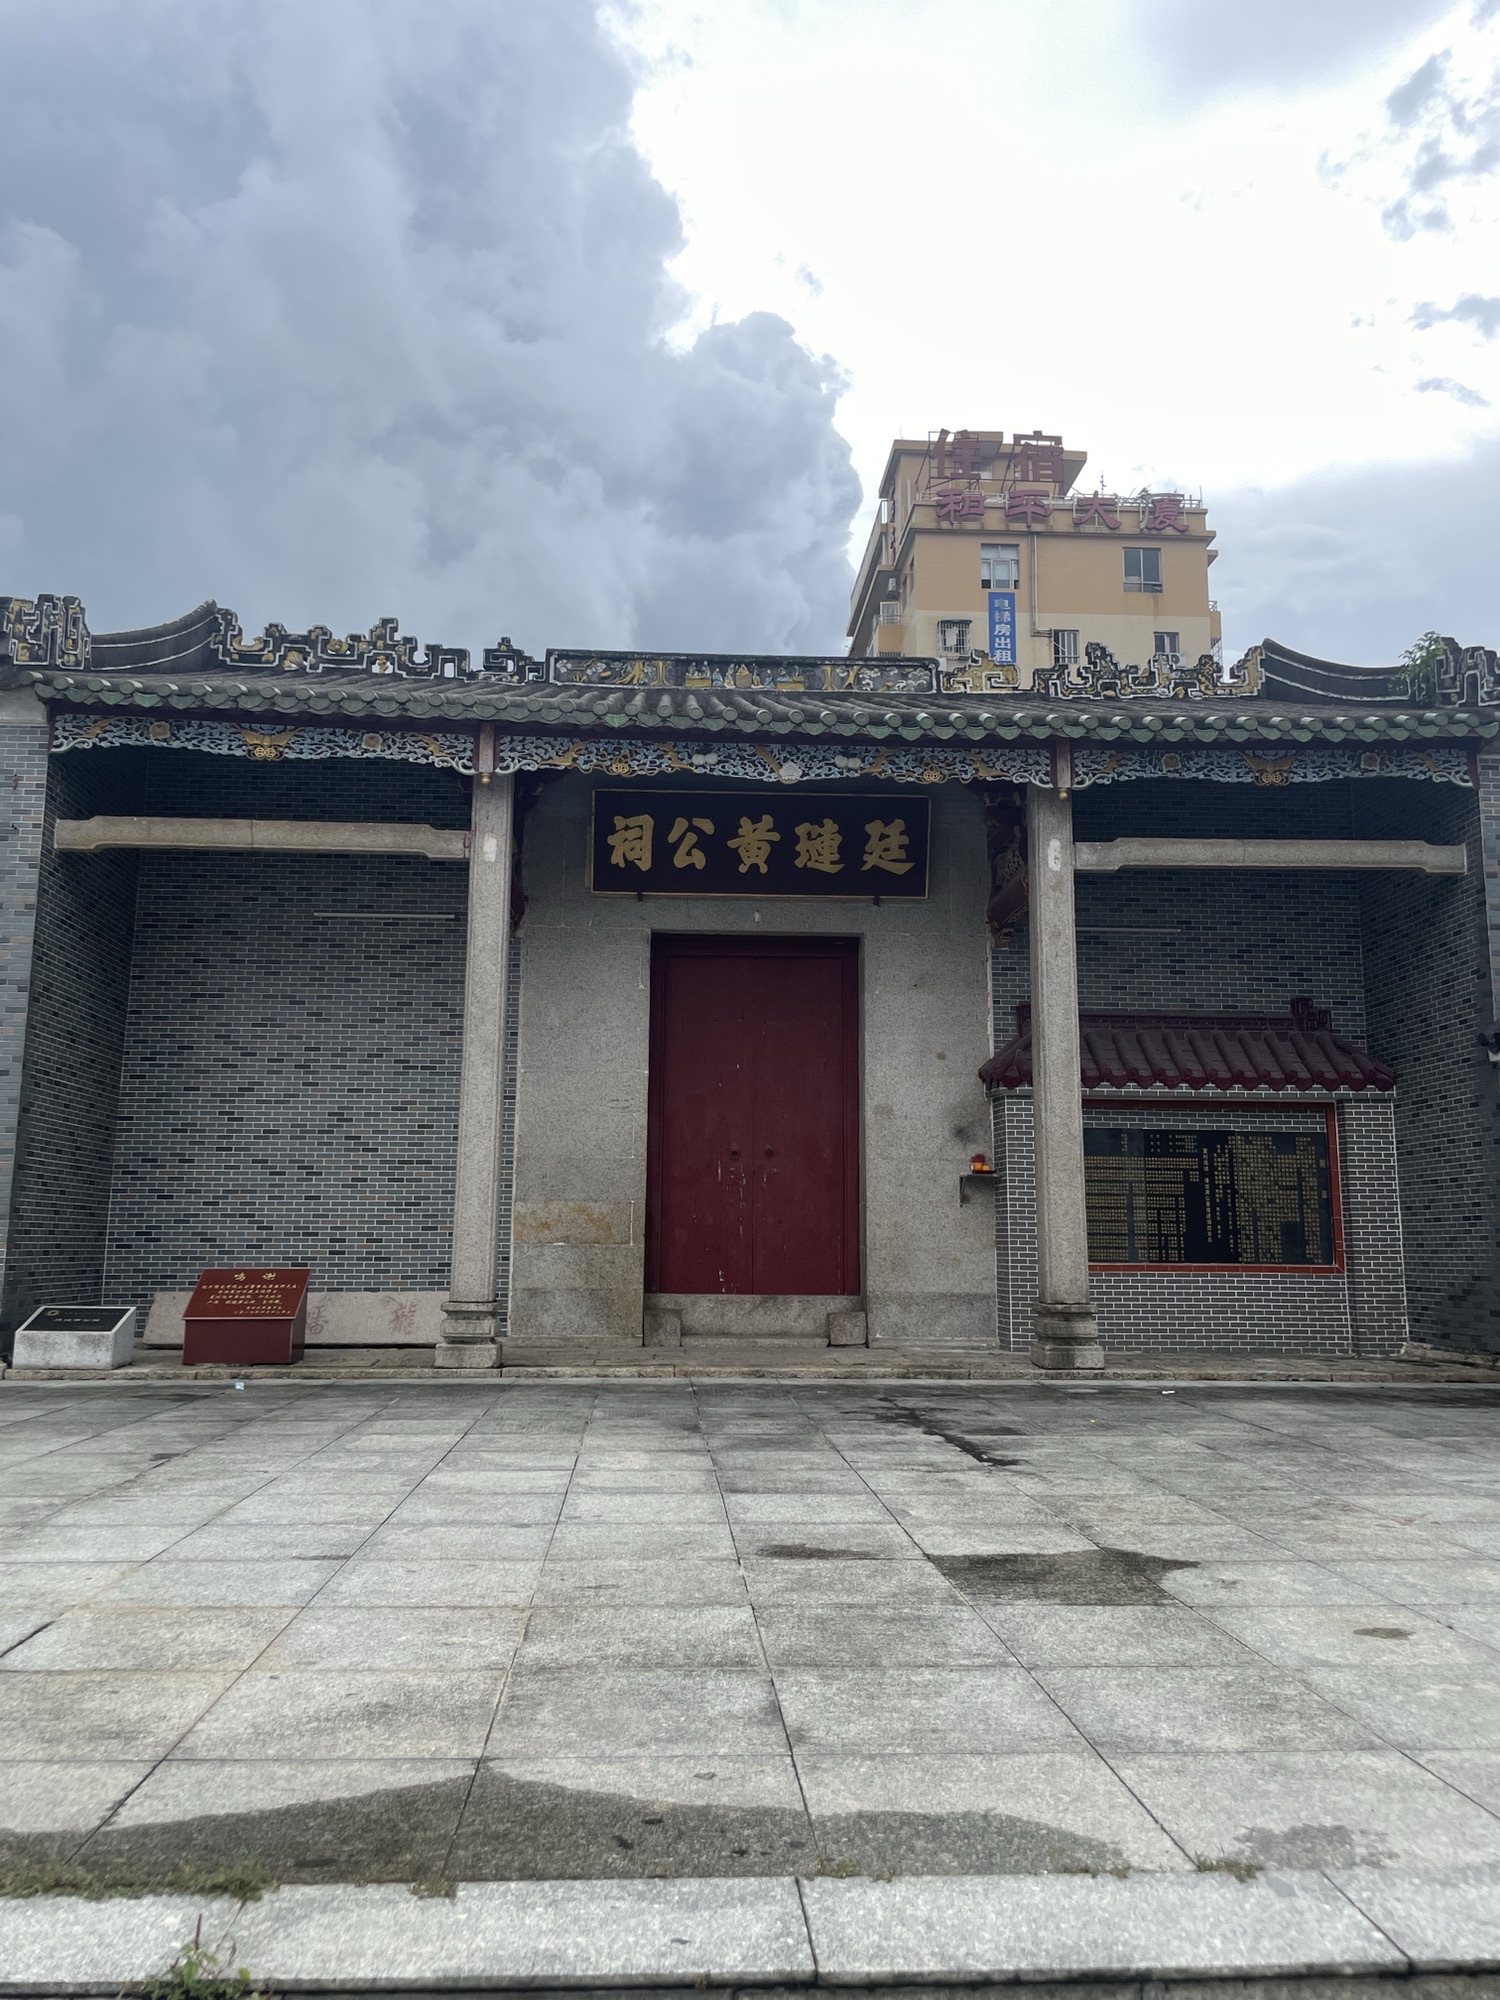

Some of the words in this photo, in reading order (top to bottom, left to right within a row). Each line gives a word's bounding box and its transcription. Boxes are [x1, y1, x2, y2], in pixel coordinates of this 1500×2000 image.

[929, 428, 1064, 482] 住宿
[936, 488, 1190, 532] 和平大厦
[994, 598, 1012, 662] 电梯房出租
